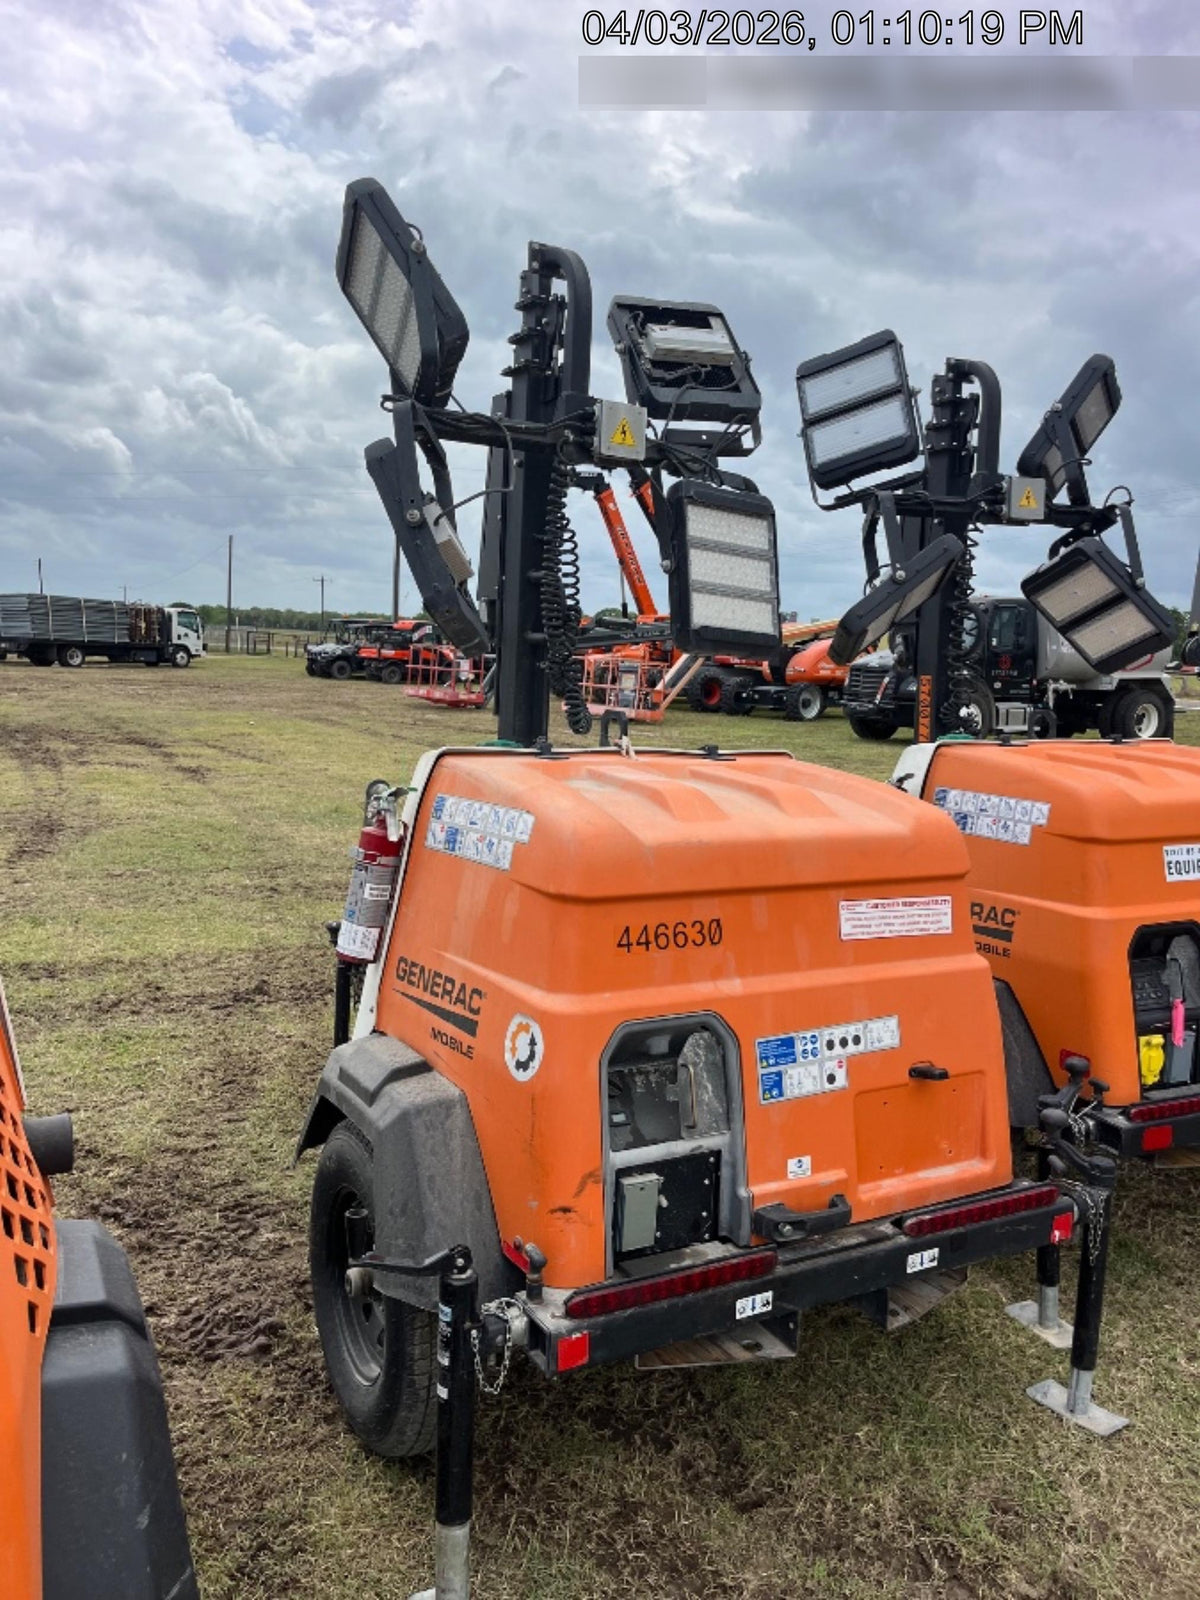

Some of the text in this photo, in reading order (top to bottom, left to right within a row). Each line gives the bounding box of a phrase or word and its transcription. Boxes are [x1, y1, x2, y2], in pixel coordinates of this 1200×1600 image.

[970, 901, 1016, 928] RAC
[616, 918, 722, 954] 446630
[974, 940, 1011, 959] OBILE
[395, 955, 483, 1016] GENERAC
[430, 1026, 476, 1060] MOBILE
